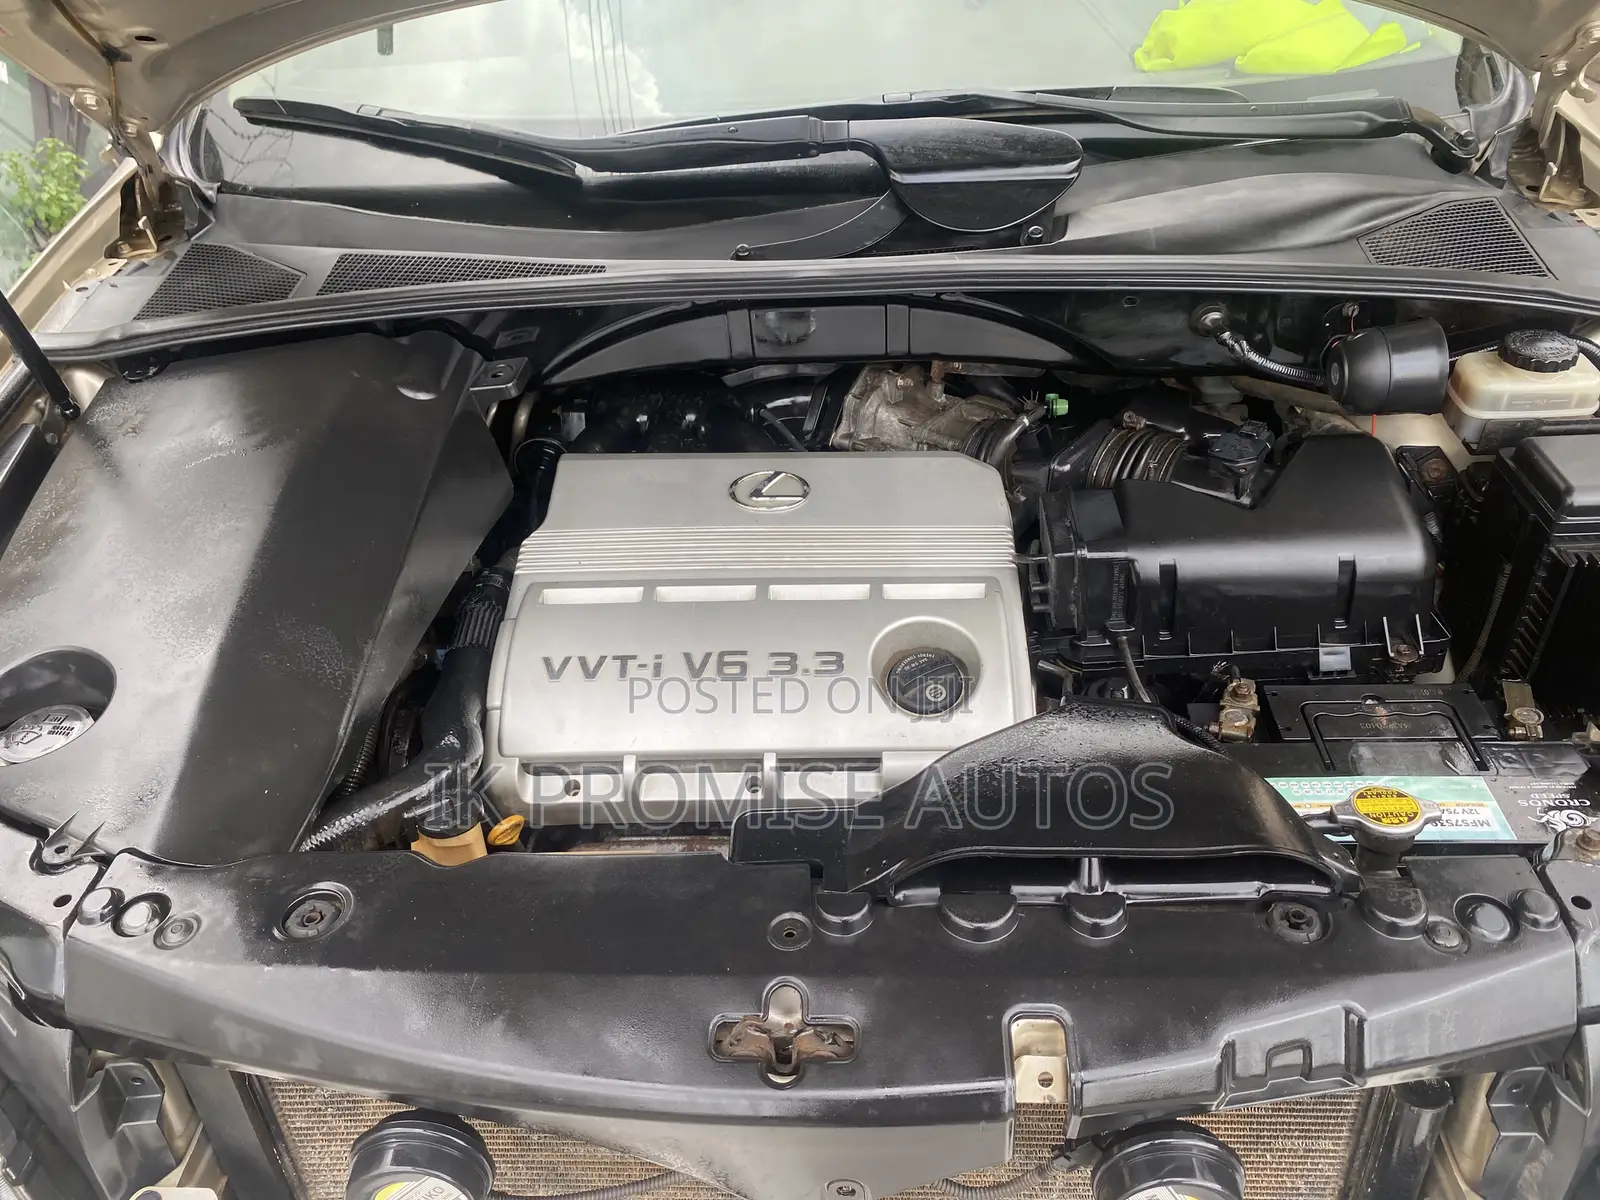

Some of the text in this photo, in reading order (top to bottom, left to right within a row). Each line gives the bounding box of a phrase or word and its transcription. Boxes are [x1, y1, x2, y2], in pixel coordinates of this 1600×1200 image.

[542, 649, 846, 683] VVT-i V6 3.3
[1517, 799, 1591, 807] CRONOS
